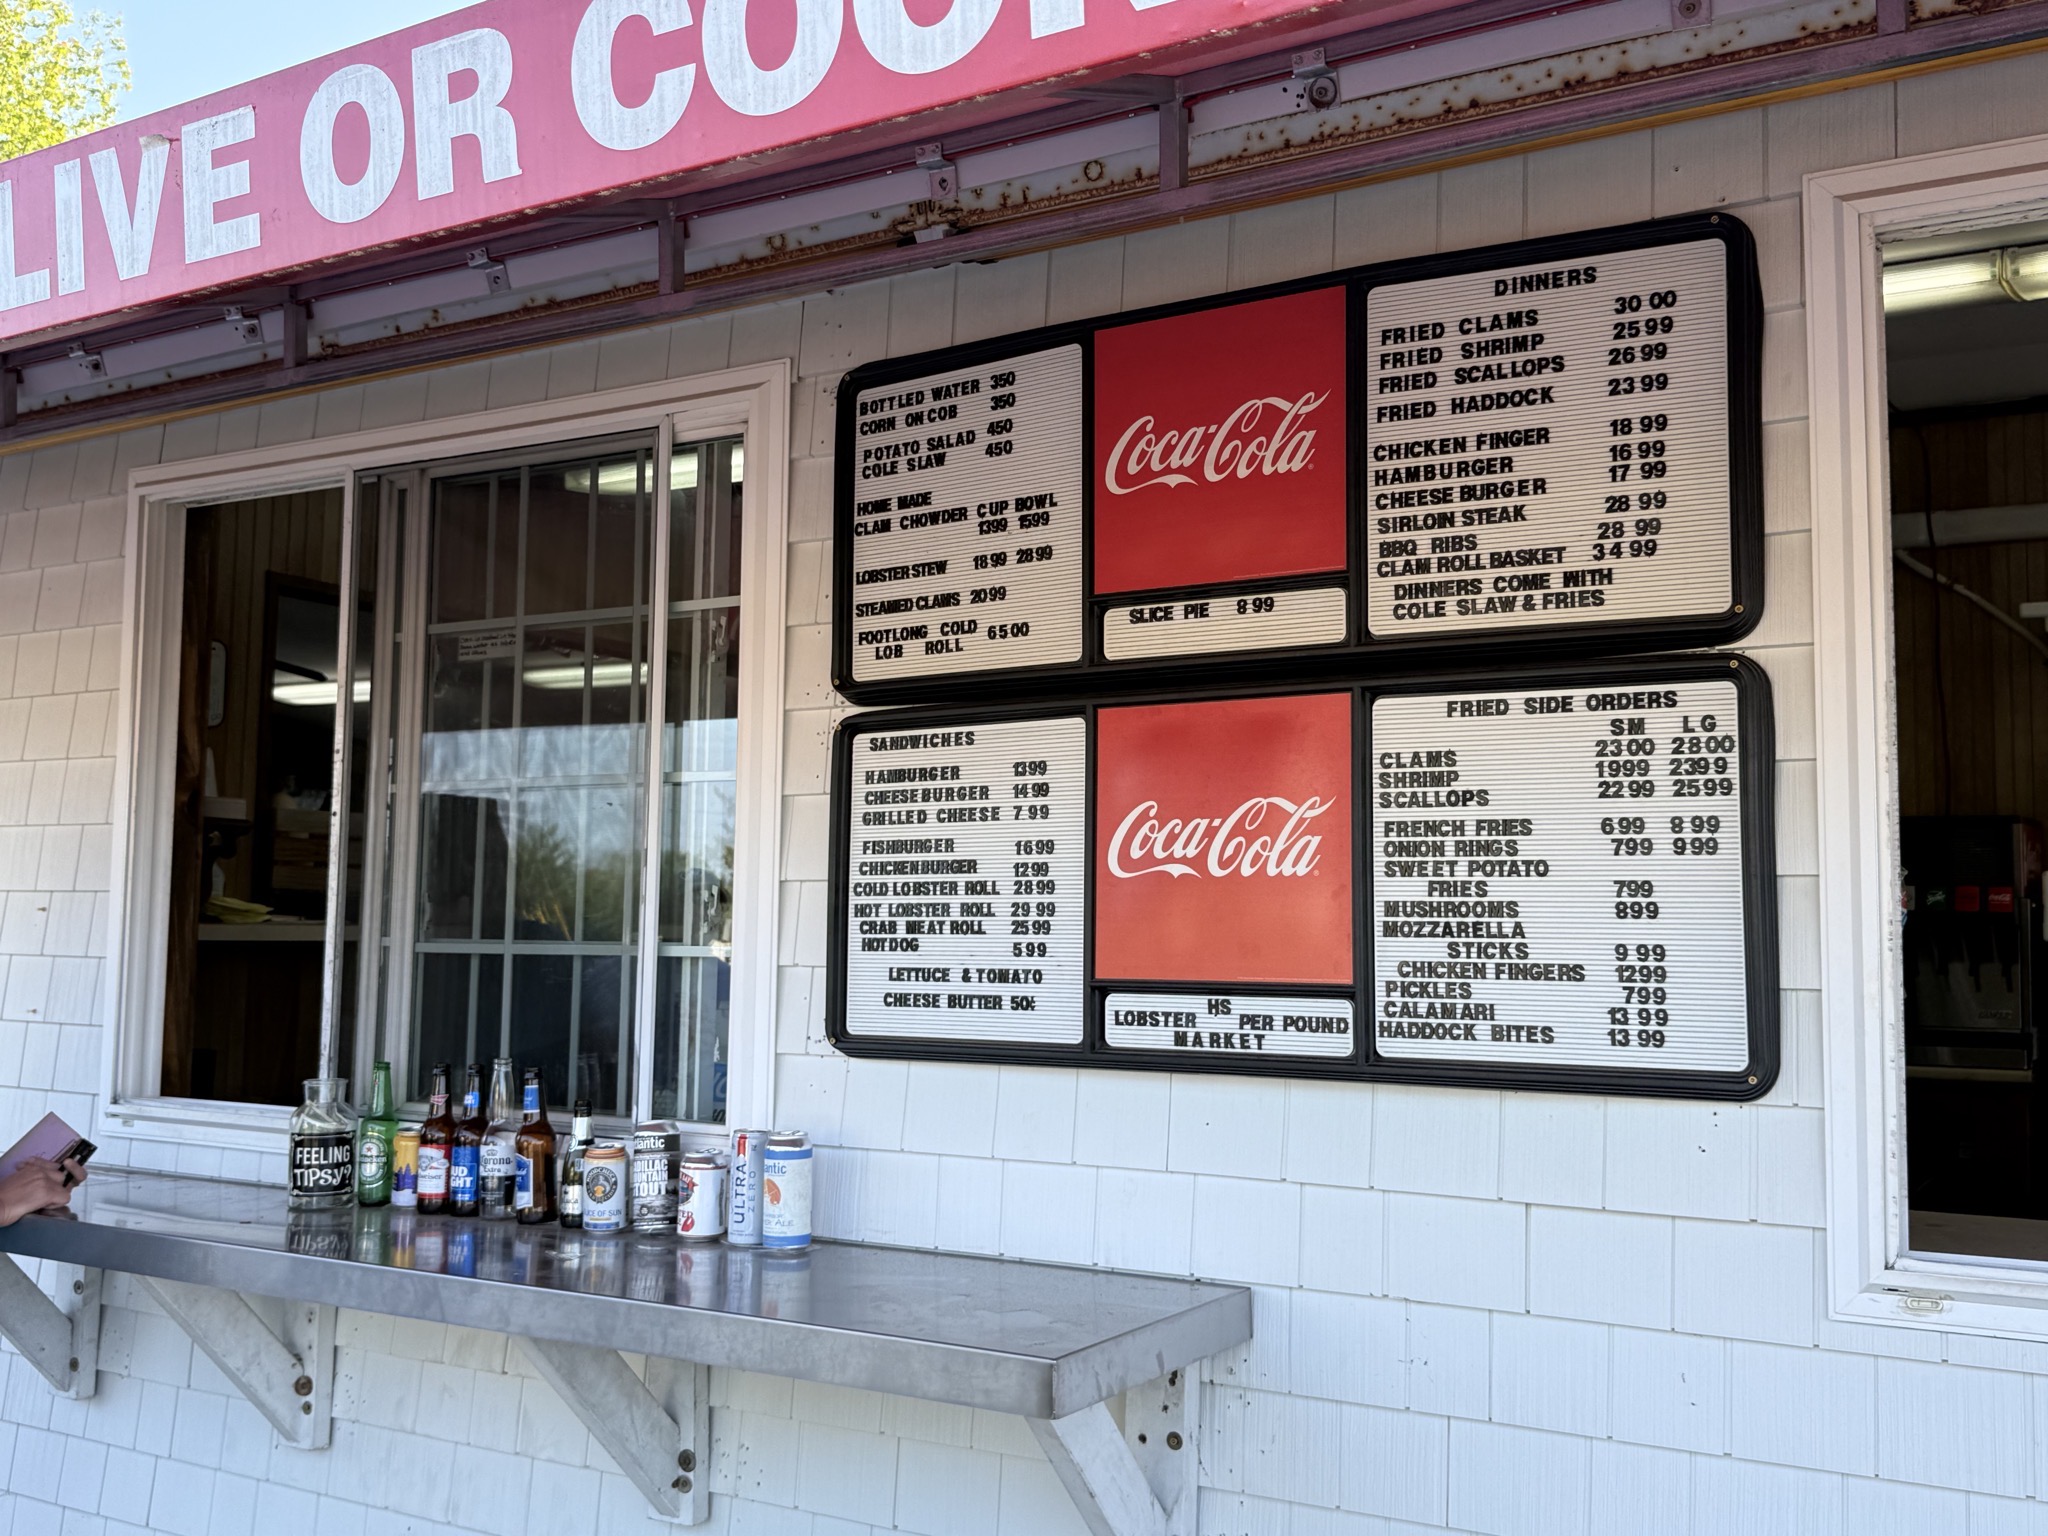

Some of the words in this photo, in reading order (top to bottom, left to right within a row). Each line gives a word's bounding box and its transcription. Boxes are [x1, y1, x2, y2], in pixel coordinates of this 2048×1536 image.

[299, 27, 523, 224] OR
[1494, 266, 1596, 296] DINNERS
[1382, 322, 1444, 346] FRIED
[1459, 310, 1539, 335] CLAMS
[1380, 347, 1442, 370] FRIED
[1461, 334, 1544, 360] SHRIMP
[1379, 371, 1437, 393] FRIED
[1454, 355, 1564, 384] SCALLOPS
[860, 391, 924, 415] BOTTLED
[931, 379, 980, 401] WATER
[990, 371, 1015, 389] 350
[860, 417, 895, 435] CORN
[991, 393, 1016, 411] 350
[1377, 400, 1436, 422] FRIED
[1451, 386, 1554, 414] HADDOCK
[864, 440, 920, 463] POTATO
[927, 430, 976, 451] SALAD
[987, 419, 1012, 436] 450
[1105, 389, 1331, 494] Coca-Cola
[1374, 437, 1466, 461] CHICKEN
[1476, 427, 1550, 453] FINGER
[862, 460, 898, 479] COLE
[907, 452, 946, 471] SLAW
[986, 440, 1012, 457] 450
[1375, 456, 1513, 486] HAMBURGER
[855, 519, 891, 536] CLAM
[900, 507, 968, 530] CHOWDER
[977, 501, 1008, 518] CUP
[1015, 493, 1057, 512] BOWL
[857, 498, 892, 516] HOME
[897, 492, 932, 510] MADE
[978, 518, 1008, 535] 1399
[1018, 512, 1049, 530] 1599
[1378, 512, 1454, 533] SIRLOIN
[1462, 505, 1526, 527] STEAK
[1379, 539, 1417, 557] BBQ
[1432, 534, 1477, 553] RIBS
[1377, 557, 1430, 577] CLAM
[1437, 553, 1486, 573] ROLL
[1490, 547, 1566, 568] BASKET
[1394, 578, 1482, 600] DINNERS
[1494, 573, 1550, 593] COME
[1563, 568, 1613, 588] WITH
[1129, 606, 1173, 624] SLICE
[1184, 602, 1209, 619] PIE
[1393, 601, 1446, 620] COLE
[1457, 596, 1517, 617] SLAW
[1522, 595, 1536, 611] &
[1543, 590, 1605, 610] FRIES
[941, 620, 977, 636] COLD
[876, 645, 903, 660] LOB
[925, 639, 963, 655] ROLL
[1448, 699, 1508, 717] FRIED
[1524, 696, 1573, 714] SIDE
[1586, 691, 1678, 711] ORDERS
[870, 732, 975, 751] SANDWICHES
[1380, 751, 1457, 769] CLAMS
[866, 766, 959, 784] HAMBURGER
[1379, 771, 1459, 788] SHRIMP
[1379, 789, 1489, 808] SCALLOPS
[862, 809, 927, 826] GRILLED
[936, 806, 1000, 823] CHEESE
[1108, 795, 1336, 878] Coca-Cola
[1384, 820, 1465, 838] FRENCH
[1476, 818, 1532, 836] FRIES
[863, 838, 954, 855] FISHBURGER
[1384, 841, 1445, 858] ONION
[1455, 839, 1518, 857] RINGS
[1384, 860, 1458, 878] SWEET
[1468, 859, 1549, 878] POTATO
[854, 882, 888, 897] COLD
[893, 881, 958, 896] LOBSTER
[965, 880, 999, 895] ROLL
[1428, 881, 1488, 897] FRIES
[854, 904, 882, 917] HOT
[889, 903, 950, 917] LOBSTER
[960, 902, 995, 917] ROLL
[1384, 902, 1519, 918] MUSHROOMS
[860, 921, 896, 935] CRAB
[906, 921, 945, 935] MEAT
[950, 921, 986, 935] ROLL
[1383, 921, 1526, 938] MOZZARELLA
[1448, 942, 1529, 960] STICKS
[889, 967, 950, 982] LETTUCE
[961, 968, 971, 982] &
[977, 969, 1043, 984] TOMATO
[1398, 961, 1487, 979] CHICKEN
[1495, 963, 1585, 982] FINGERS
[1386, 981, 1472, 998] PICKLES
[884, 993, 940, 1008] CHEESE
[948, 994, 1003, 1010] BUTTER
[1384, 1002, 1495, 1021] CALAMARI
[1115, 1011, 1196, 1027] LOBSTER
[1240, 1014, 1273, 1030] PER
[1283, 1016, 1348, 1033] POUND
[1379, 1021, 1477, 1041] HADDOCK
[1491, 1025, 1554, 1044] BITES
[1174, 1031, 1265, 1050] MARKET
[297, 1146, 350, 1164] FEELING
[482, 1155, 512, 1166] Corona
[452, 1166, 467, 1175] UD
[765, 1163, 787, 1174] antic
[451, 1177, 473, 1187] GHT
[634, 1182, 668, 1196] TOUT
[748, 1171, 756, 1212] ZERO
[734, 1163, 746, 1223] ULTRA
